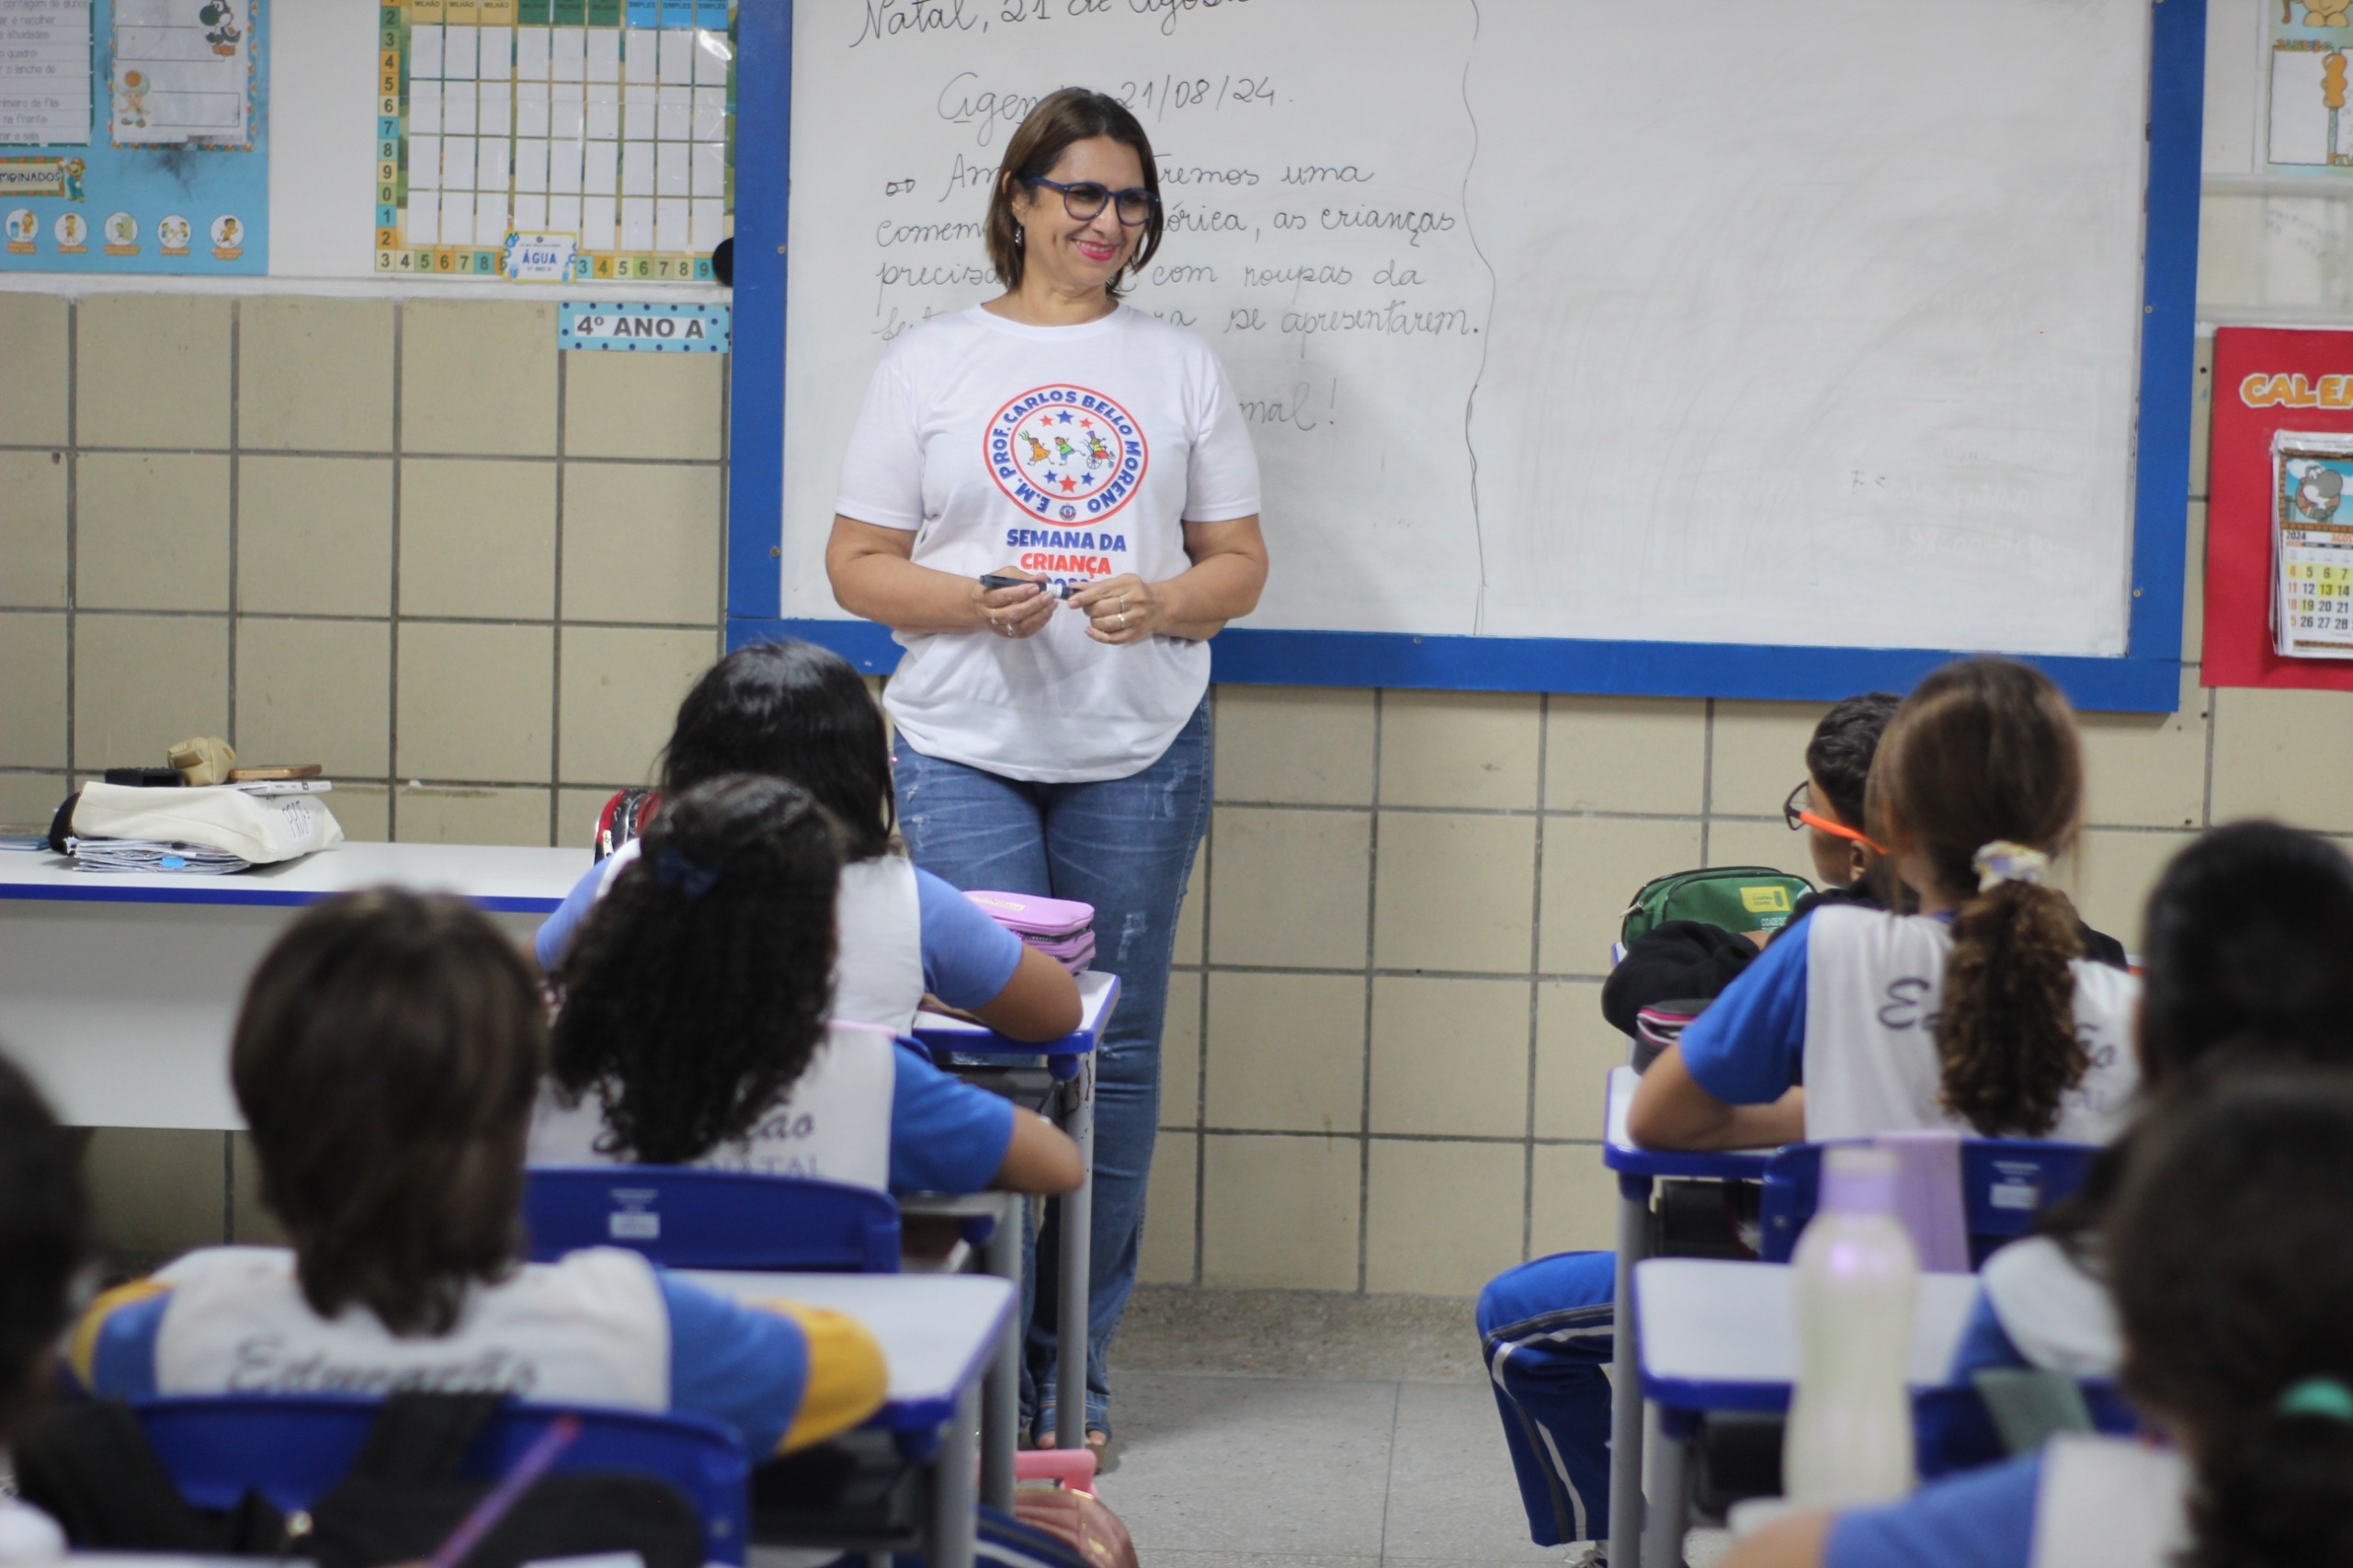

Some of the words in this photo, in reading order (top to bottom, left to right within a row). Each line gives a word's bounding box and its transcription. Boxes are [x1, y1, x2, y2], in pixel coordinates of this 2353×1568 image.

[386, 10, 395, 25] 2
[849, 0, 988, 47] Natal,
[1001, 0, 1051, 22] 21
[385, 32, 394, 47] 3
[384, 54, 394, 69] 4
[384, 77, 393, 91] 5
[384, 98, 393, 113] 6
[938, 72, 1065, 147] Agen
[384, 120, 393, 135] 7
[383, 142, 392, 157] 8
[382, 165, 392, 179] 9
[1281, 165, 1374, 187] uma
[382, 187, 392, 201] 0
[383, 209, 391, 223] 1
[1273, 211, 1306, 230] as
[1322, 204, 1455, 248] crianças
[381, 232, 391, 245] 2
[522, 249, 557, 264] ÁGUA
[381, 254, 390, 267] 3
[400, 254, 410, 268] 4
[420, 255, 429, 268] 5
[440, 256, 449, 269] 6
[460, 256, 469, 270] 7
[480, 256, 489, 270] 8
[578, 260, 587, 274] 3
[598, 261, 608, 275] 4
[619, 261, 628, 275] 5
[639, 261, 648, 276] 6
[659, 262, 668, 276] 7
[679, 262, 688, 276] 8
[699, 263, 709, 277] 9
[876, 262, 999, 317] precisa
[1152, 263, 1218, 286] com
[1245, 263, 1352, 305] roupas
[1373, 259, 1427, 287] da
[577, 316, 604, 336] 4º
[613, 317, 676, 338] ANO
[685, 319, 705, 339] A
[1223, 308, 1265, 334] se
[1281, 300, 1479, 359] apresentarem.
[1003, 391, 1077, 424] CARLOS
[1081, 395, 1132, 436] BELLO
[993, 426, 1017, 480] PROF.
[1086, 440, 1142, 514] MORENO
[1006, 529, 1095, 550] SEMANA
[1099, 534, 1127, 551] DA
[1020, 553, 1112, 579] CRIANÇA
[2290, 565, 2296, 577] 4
[2306, 566, 2313, 578] 5
[2324, 567, 2331, 579] 6
[2341, 568, 2348, 581] 7
[2289, 582, 2297, 595] 11
[2303, 583, 2315, 595] 12
[2321, 584, 2333, 596] 13
[2337, 585, 2350, 597] 14
[2302, 599, 2314, 611] 19
[2318, 600, 2332, 612] 20
[2336, 602, 2348, 613] 21
[2301, 615, 2313, 628] 26
[2318, 617, 2331, 629] 27
[2335, 618, 2348, 630] 28
